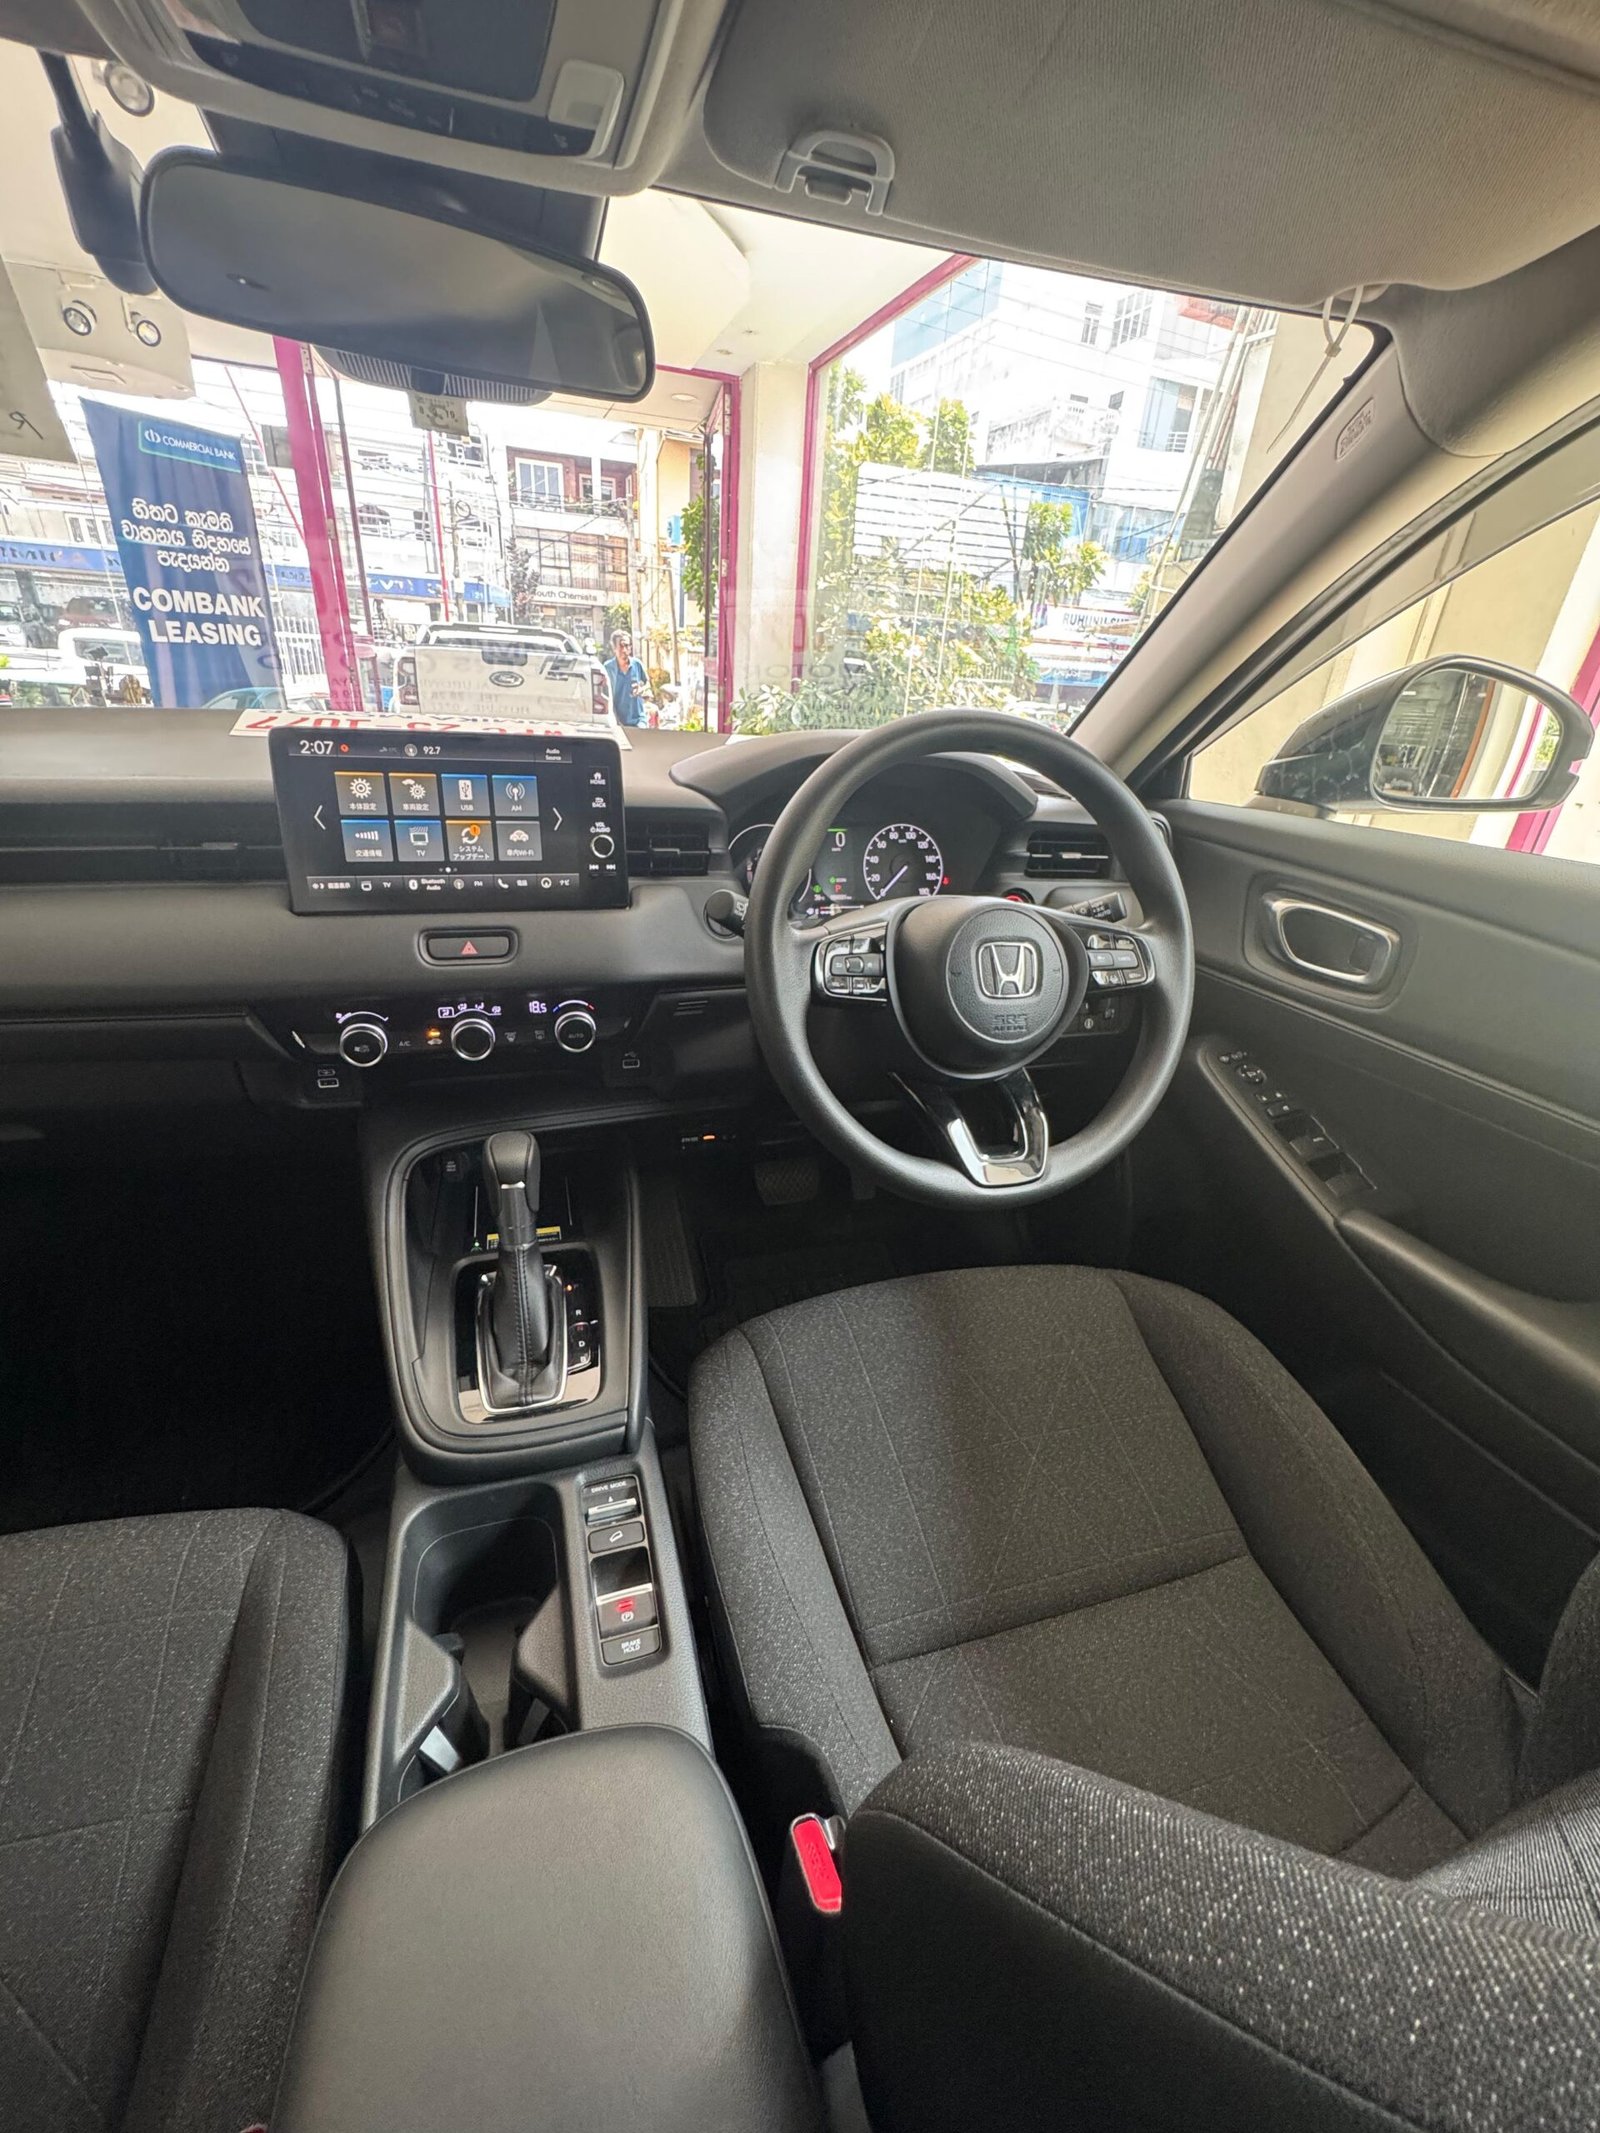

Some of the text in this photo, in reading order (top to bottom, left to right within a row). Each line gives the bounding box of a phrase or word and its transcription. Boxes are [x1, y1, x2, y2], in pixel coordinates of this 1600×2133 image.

[163, 435, 236, 460] COMMERCIAL BANK
[558, 590, 598, 602] Chemists
[133, 587, 265, 618] COMBANK
[148, 619, 262, 646] LEASING
[299, 739, 334, 755] 2:07
[422, 745, 441, 755] 92.7
[460, 804, 475, 812] USB
[835, 831, 846, 848] 0
[889, 831, 899, 840] 80
[905, 831, 917, 840] 100
[877, 840, 887, 849] 60
[917, 841, 929, 849] 120
[416, 849, 426, 857] TV
[869, 855, 879, 864] 40
[925, 855, 937, 863] 140
[871, 873, 880, 882] 20
[382, 881, 392, 889] TV
[528, 1000, 548, 1014] 18.5
[575, 1309, 582, 1317] R
[591, 1480, 627, 1493] DRIVE MODE
[621, 1638, 641, 1649] BRAKE
